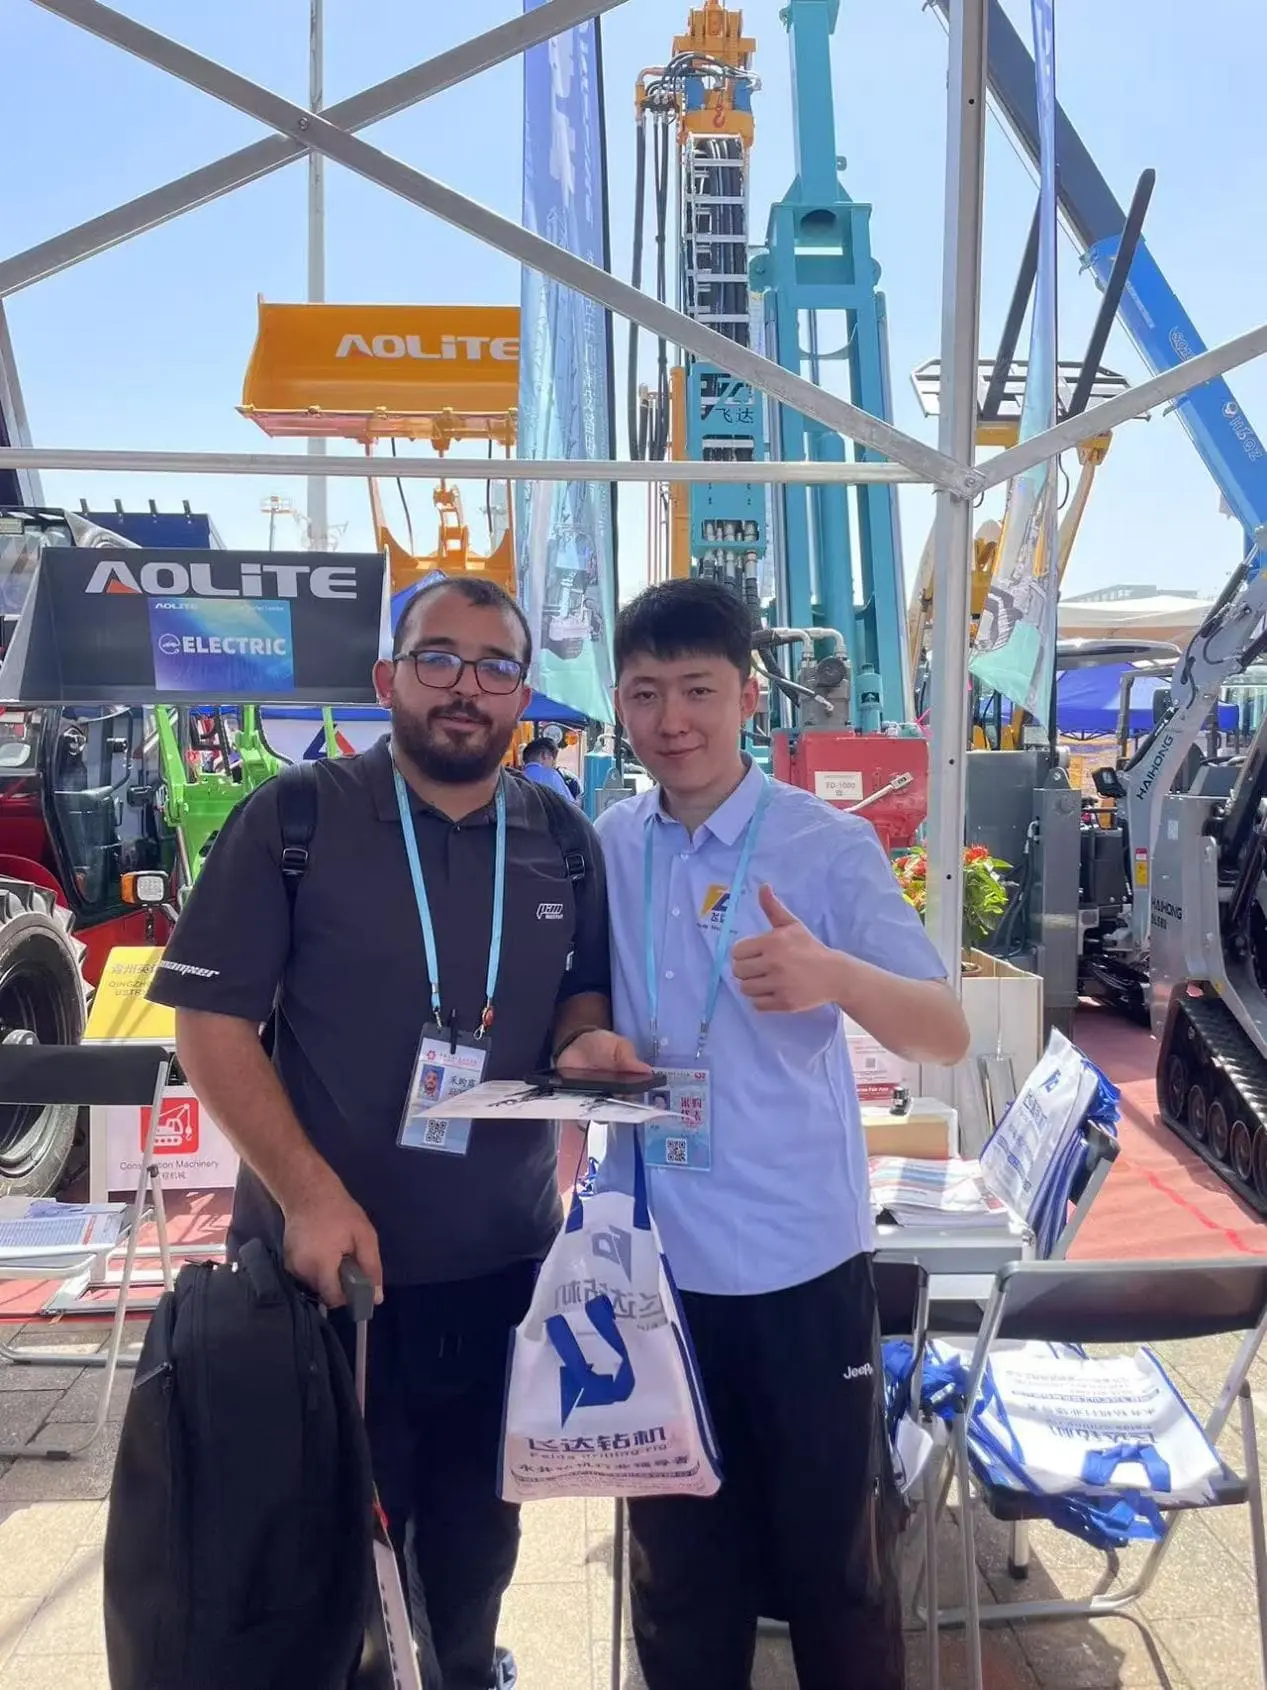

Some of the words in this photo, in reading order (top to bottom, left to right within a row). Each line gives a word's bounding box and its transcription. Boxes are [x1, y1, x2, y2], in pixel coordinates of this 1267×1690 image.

[715, 407, 755, 424] 飞达
[182, 636, 287, 656] ELECTRIC
[1136, 734, 1174, 801] HAIHONG
[120, 1161, 174, 1171] Constion
[176, 1159, 219, 1171] Machinery
[158, 1171, 187, 1181] 程机械
[526, 1426, 666, 1452] 飞达钻机
